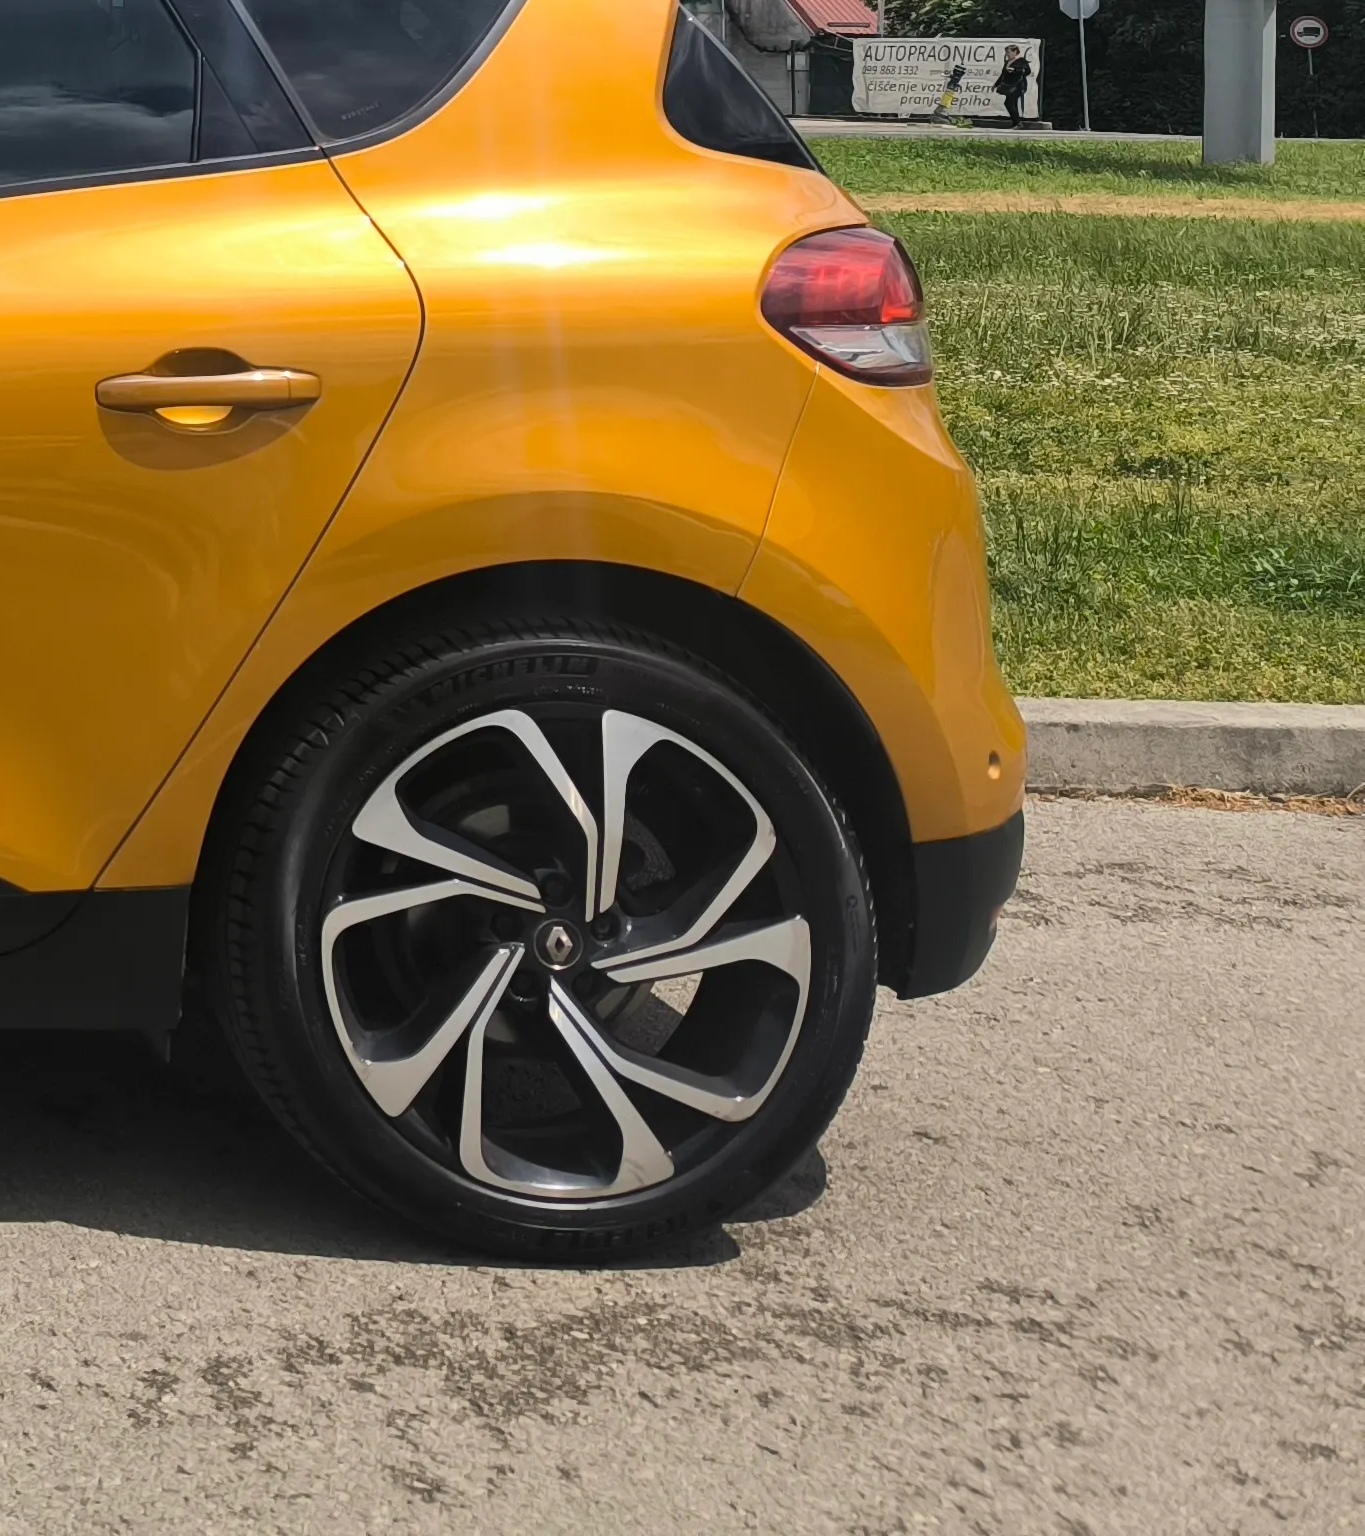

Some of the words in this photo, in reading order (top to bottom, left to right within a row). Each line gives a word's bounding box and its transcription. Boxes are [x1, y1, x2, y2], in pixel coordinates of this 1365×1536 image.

[862, 44, 996, 63] AUTOPRAONICA
[861, 65, 878, 76] 099
[879, 65, 896, 76] 868
[897, 65, 919, 76] 1332
[899, 94, 940, 107] pranje
[950, 94, 991, 109] epiha
